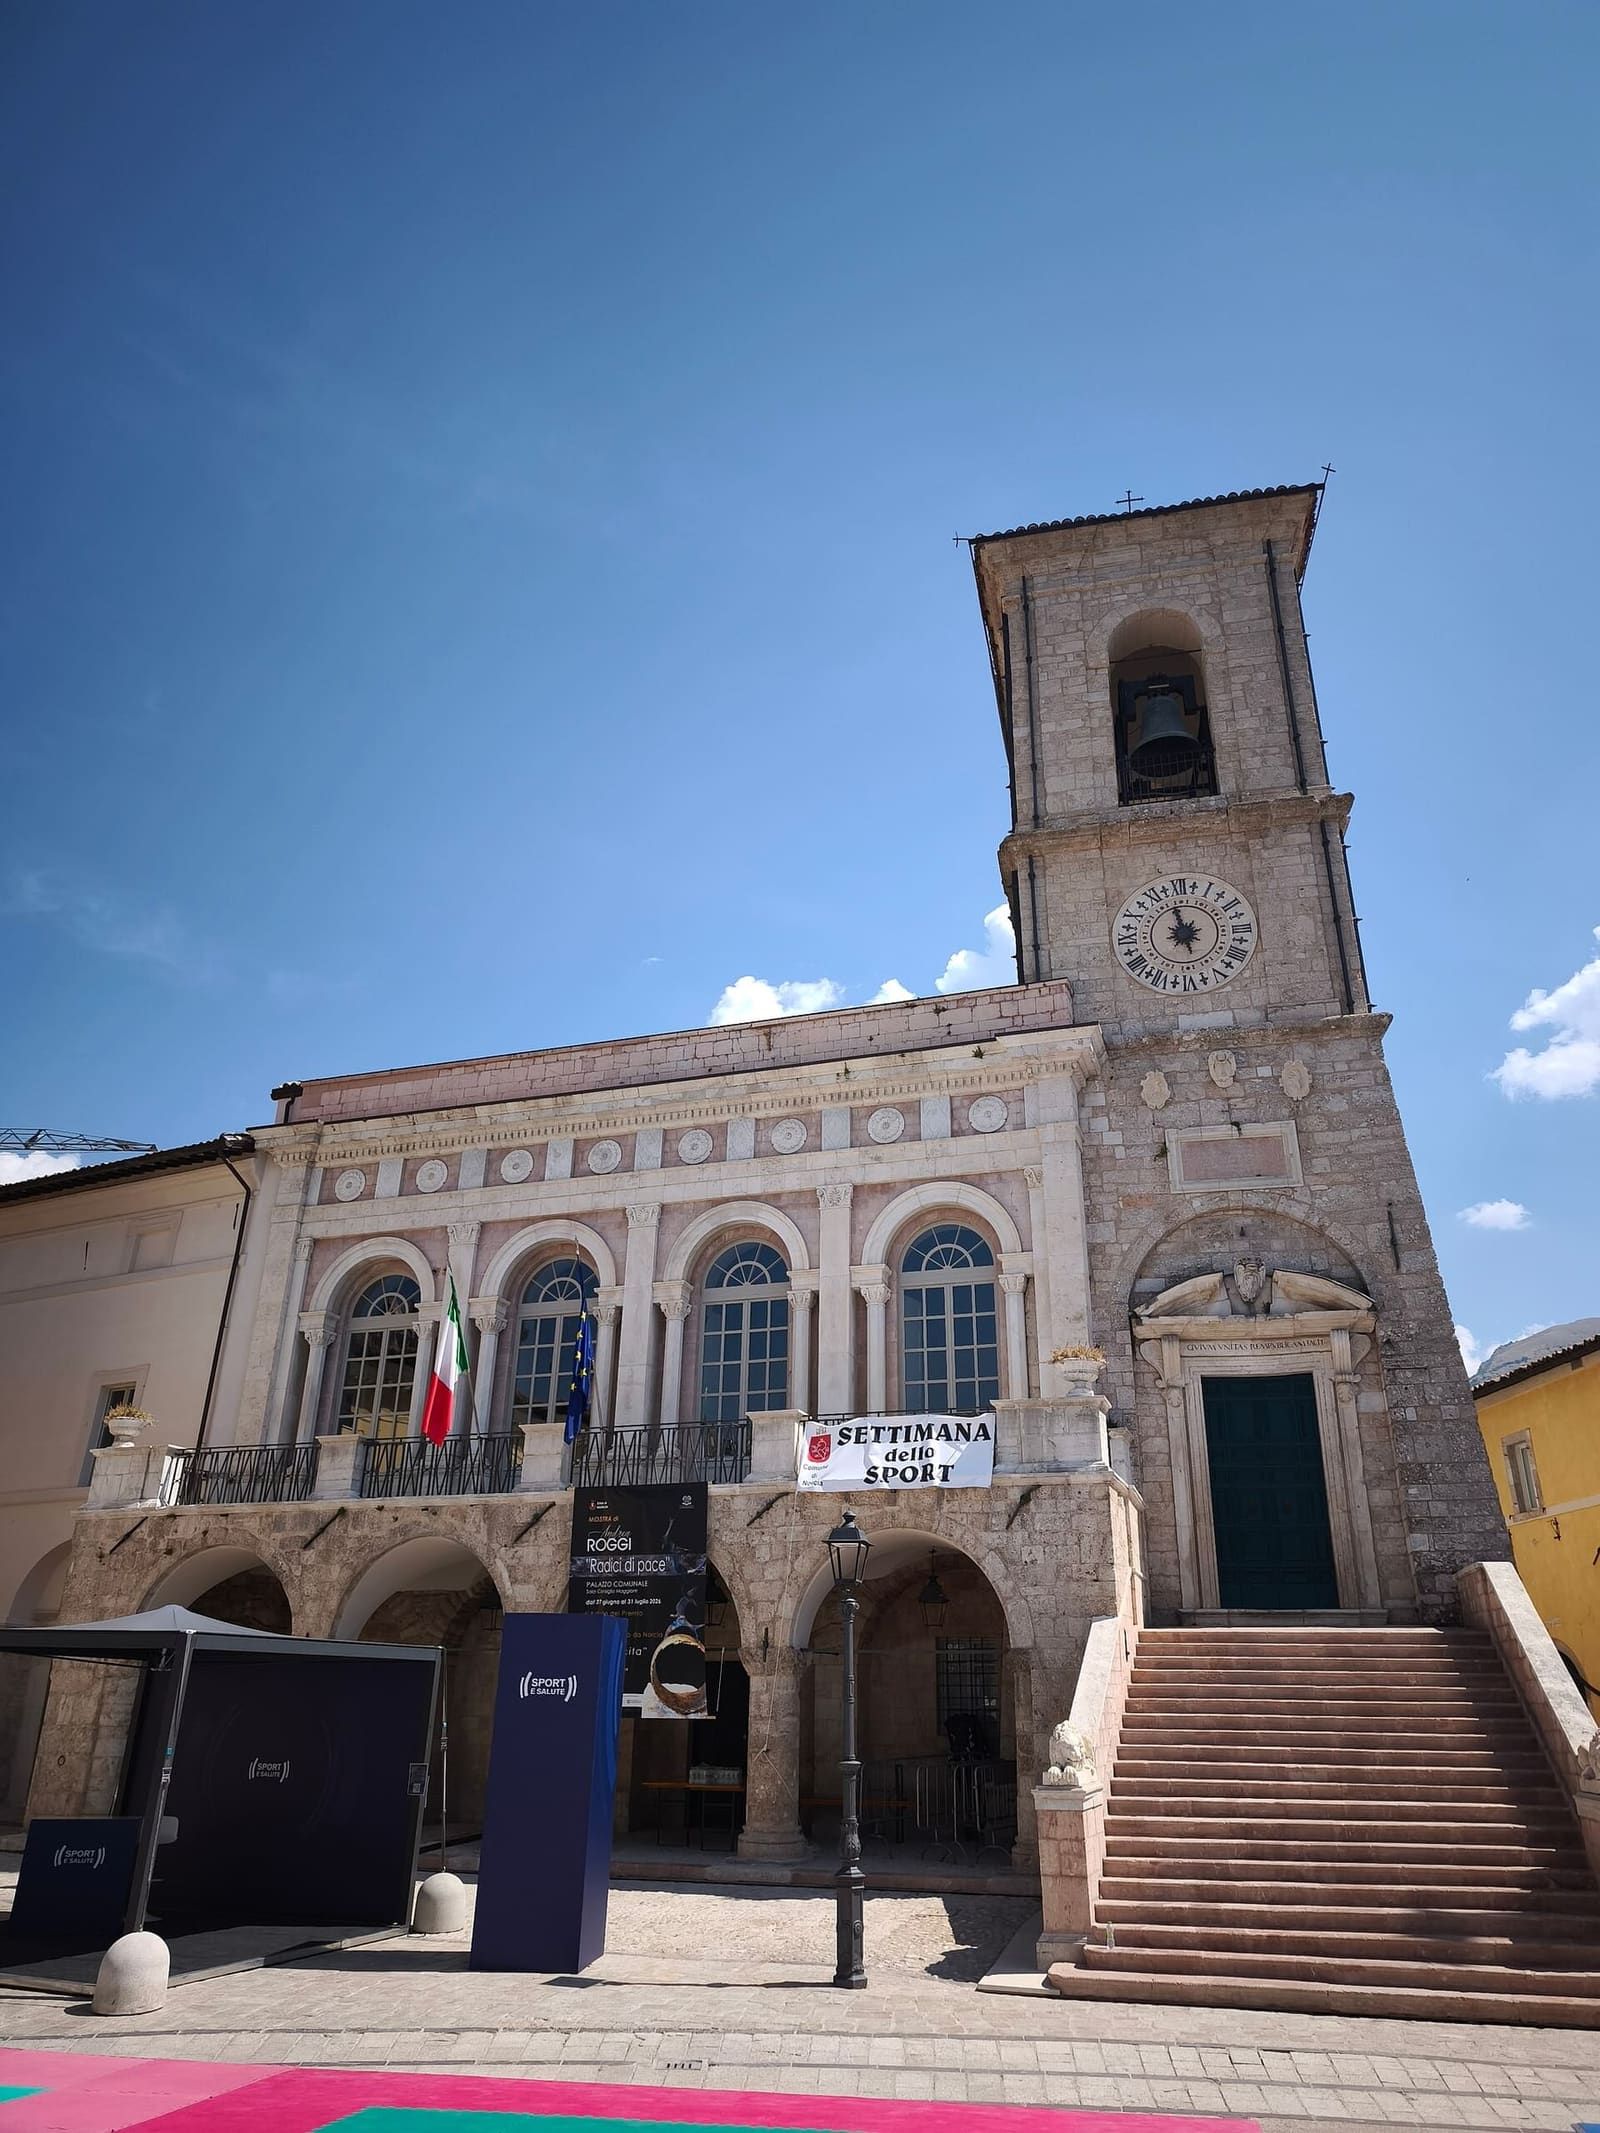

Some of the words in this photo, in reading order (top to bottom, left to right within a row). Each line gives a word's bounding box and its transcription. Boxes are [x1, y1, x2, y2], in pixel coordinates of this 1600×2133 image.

[1170, 878, 1188, 895] XII
[1202, 881, 1215, 898] I
[1142, 887, 1162, 906] XI
[1221, 897, 1242, 912] II
[1123, 908, 1144, 923] X
[1231, 923, 1252, 934] III
[1224, 944, 1249, 963] IIII
[1150, 968, 1168, 990] VII
[1182, 974, 1199, 991] VI
[1211, 967, 1230, 984] V
[837, 1422, 992, 1446] SETTIMANA
[885, 1446, 934, 1463] dello
[864, 1463, 955, 1485] SPORT
[586, 1537, 631, 1552] ROGGI
[585, 1557, 622, 1573] "Radici
[624, 1556, 635, 1572] di
[637, 1556, 670, 1576] pace"
[586, 1580, 612, 1588] PALAZZO
[613, 1580, 648, 1588] COMUNALE
[531, 1678, 566, 1688] SPORT
[257, 1762, 282, 1771] SPORT
[65, 1849, 96, 1858] SPORT
